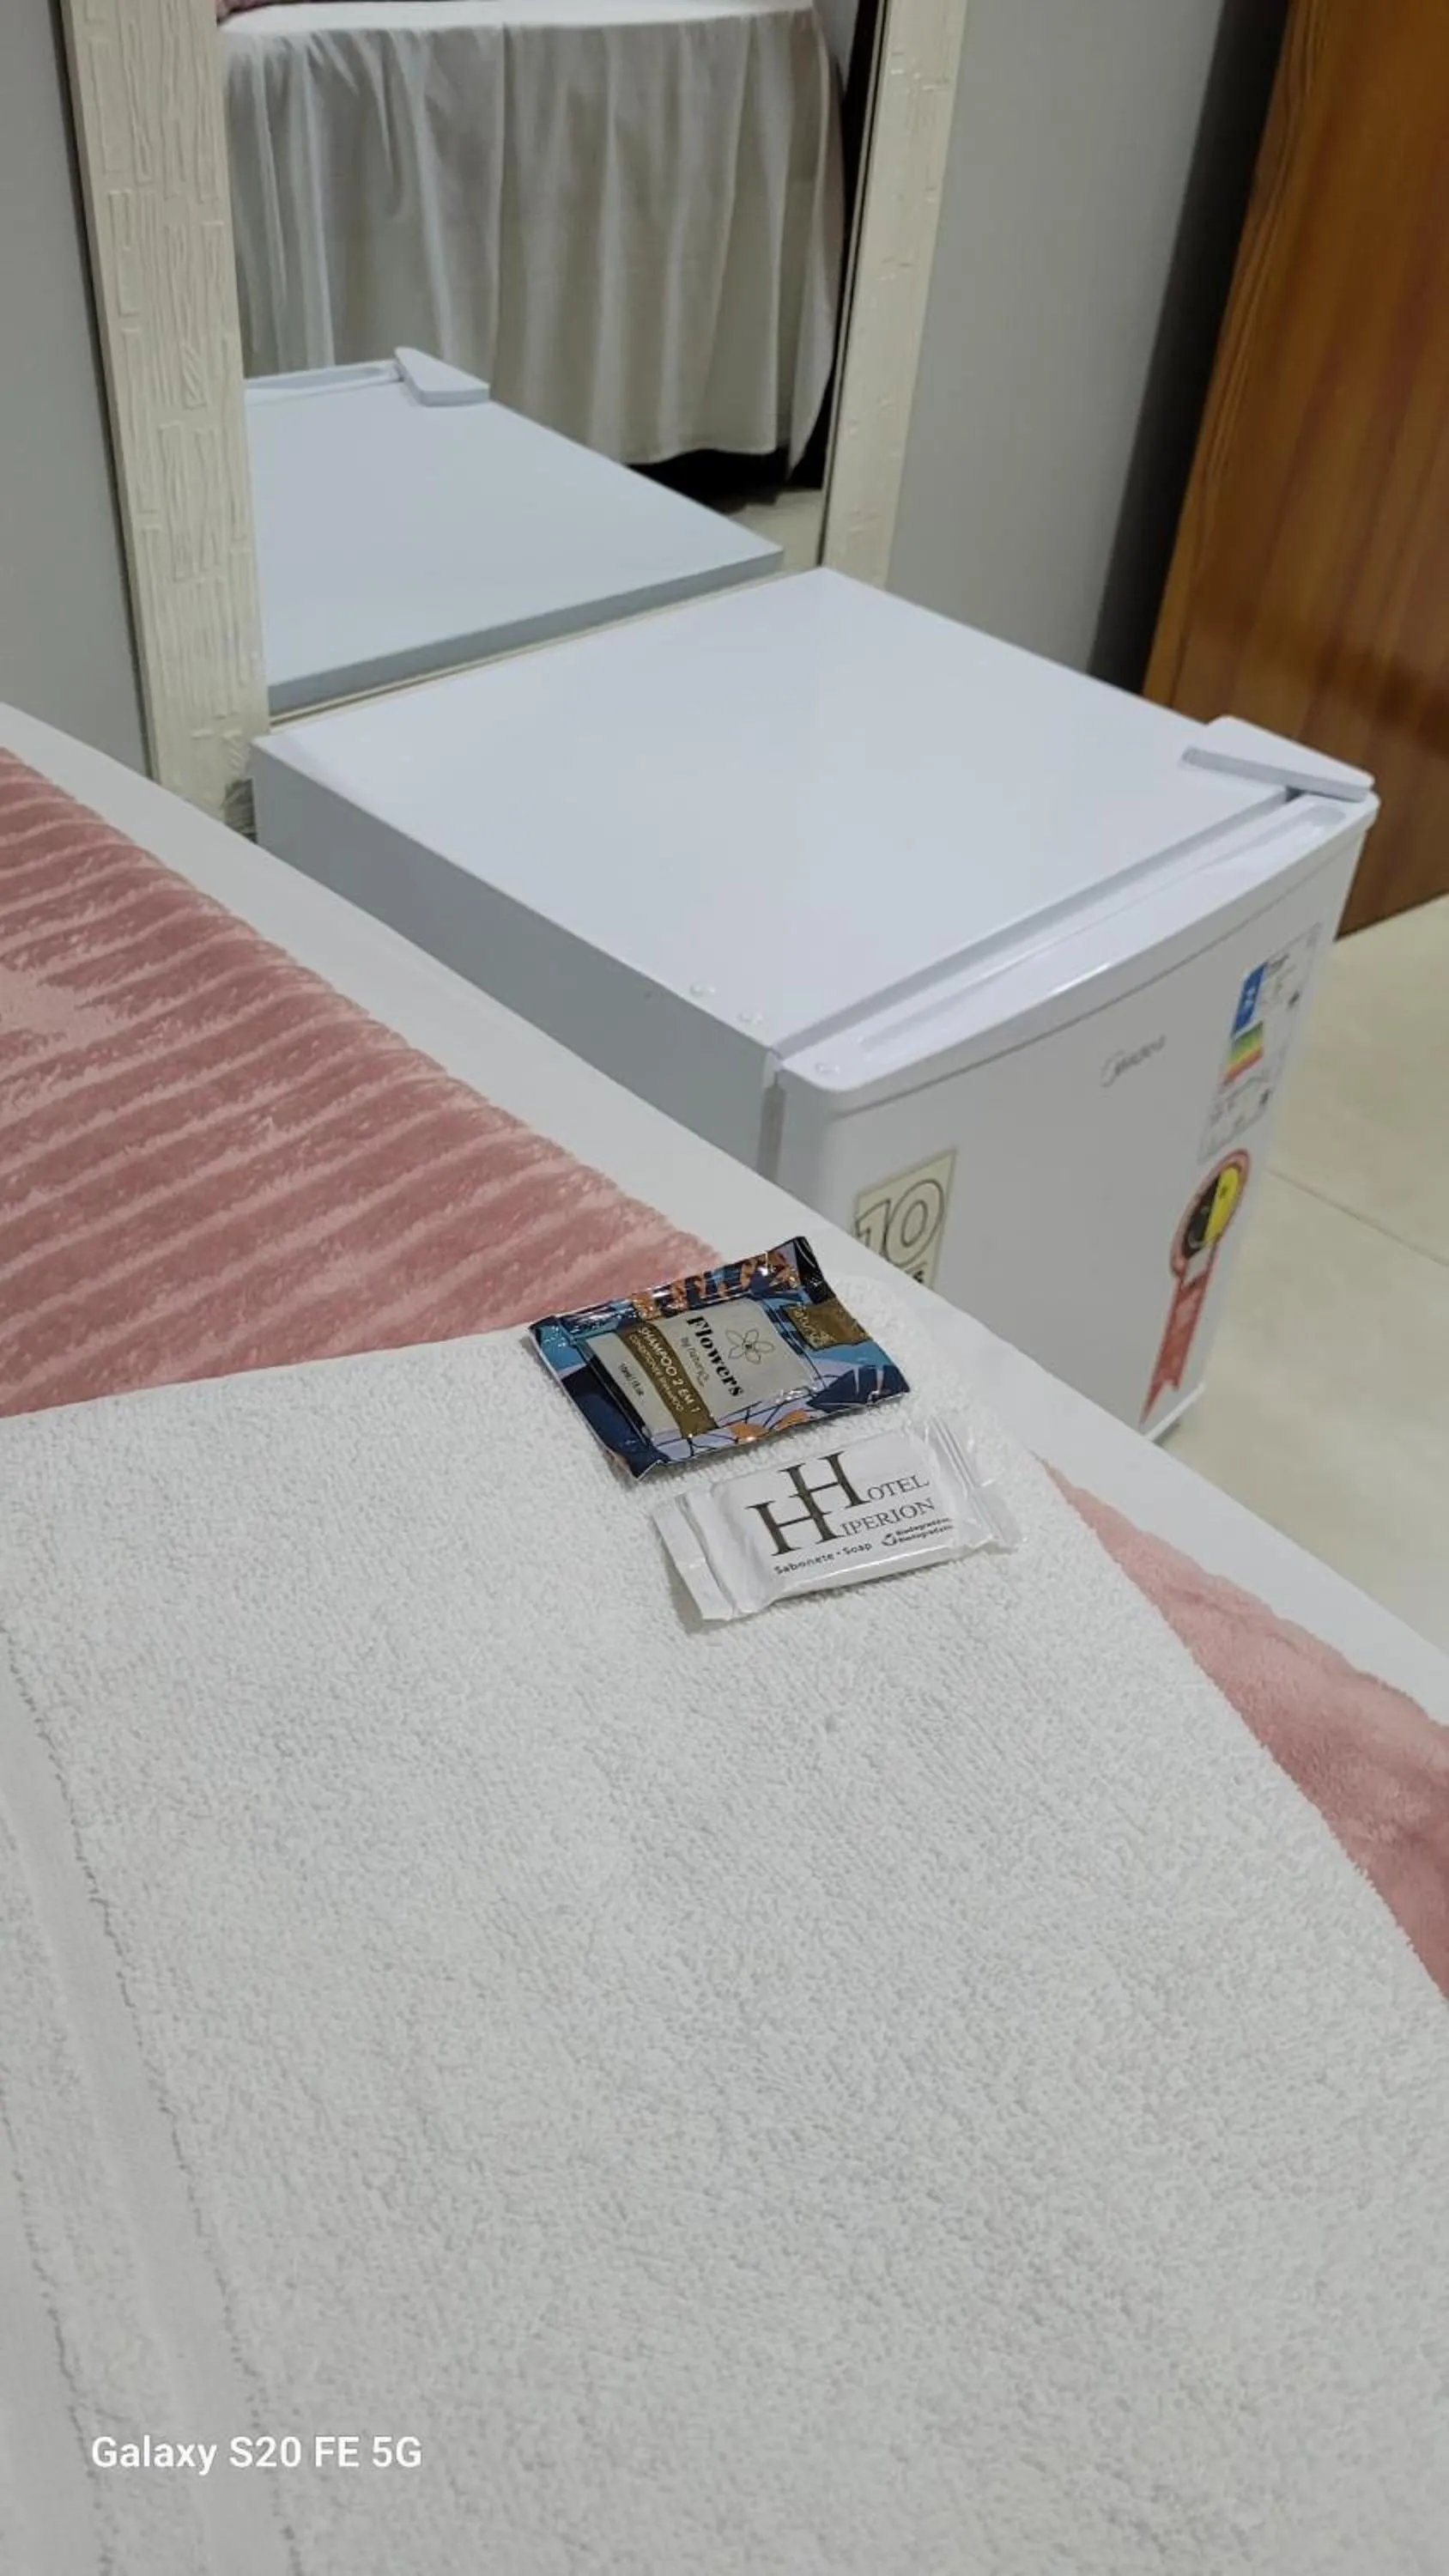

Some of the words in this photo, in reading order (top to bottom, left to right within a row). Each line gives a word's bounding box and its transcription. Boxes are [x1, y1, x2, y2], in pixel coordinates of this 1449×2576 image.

[639, 1326, 678, 1377] SHAMPOO
[686, 1315, 744, 1397] Flowers
[774, 1552, 835, 1575] Sabonete
[841, 1543, 873, 1556] Soap
